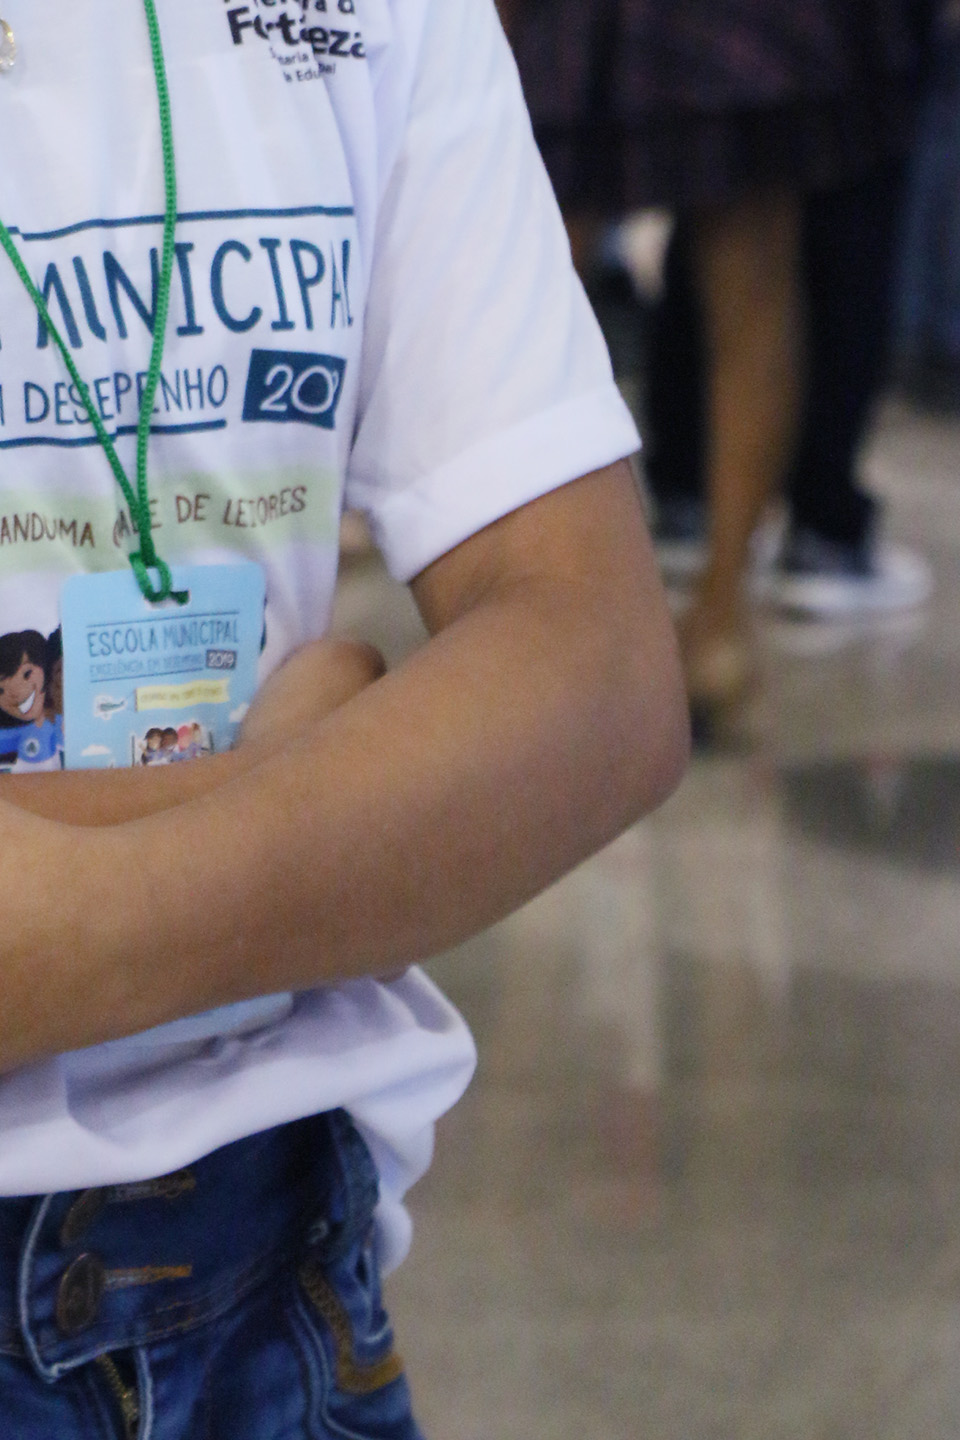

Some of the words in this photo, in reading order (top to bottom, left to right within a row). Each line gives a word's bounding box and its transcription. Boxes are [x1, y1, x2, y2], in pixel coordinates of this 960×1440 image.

[175, 491, 211, 524] DE
[87, 627, 159, 658] ESCOLA
[163, 618, 239, 649] MUNICIPAL
